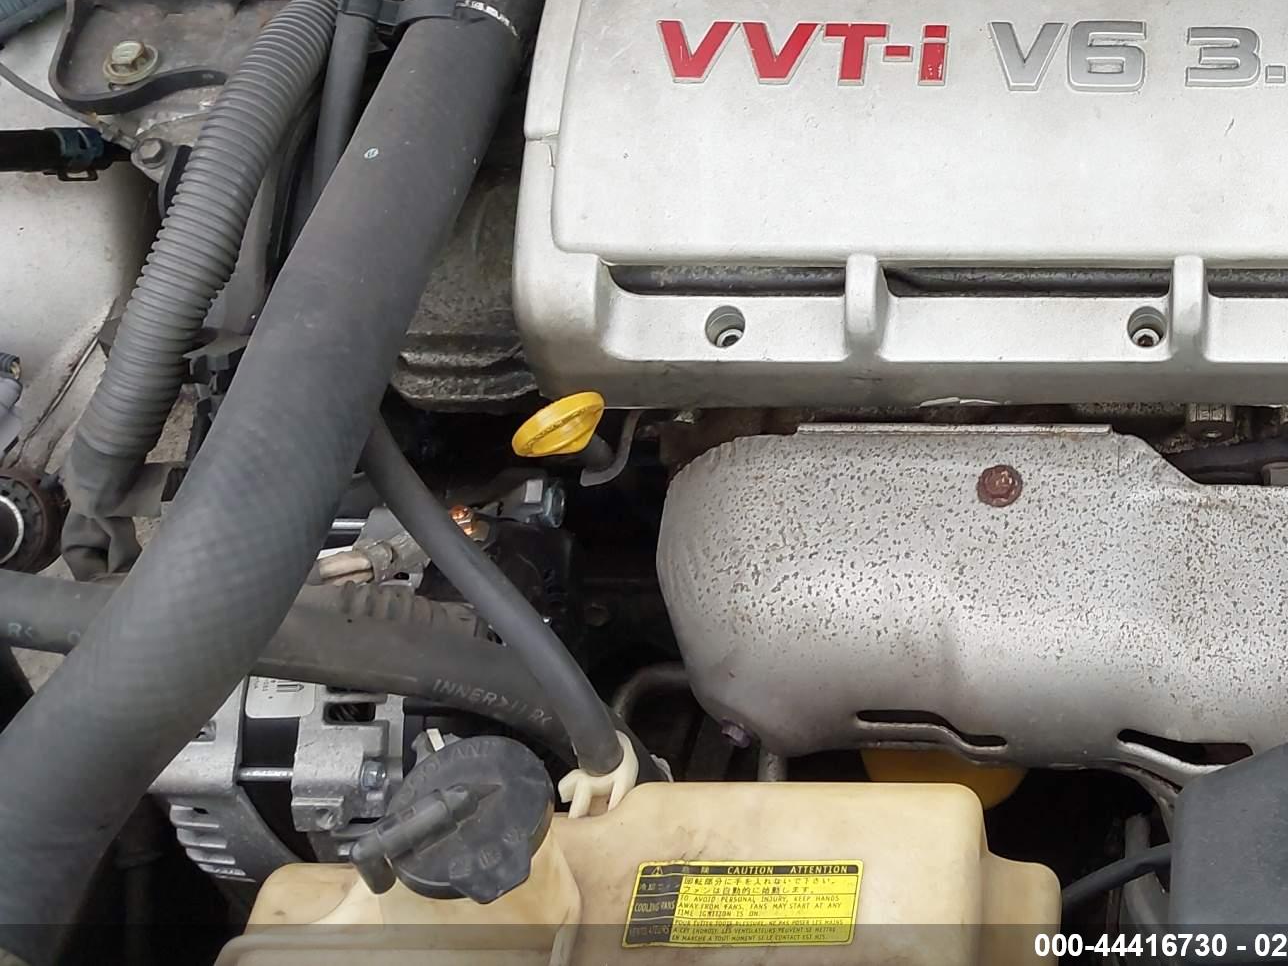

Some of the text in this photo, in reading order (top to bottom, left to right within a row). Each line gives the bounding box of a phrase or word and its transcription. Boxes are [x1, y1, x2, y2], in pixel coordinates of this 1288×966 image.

[656, 19, 951, 86] VVT-i
[987, 19, 1147, 92] V6
[727, 865, 848, 874] CAUTION ATTENTION
[634, 902, 660, 913] COOLING
